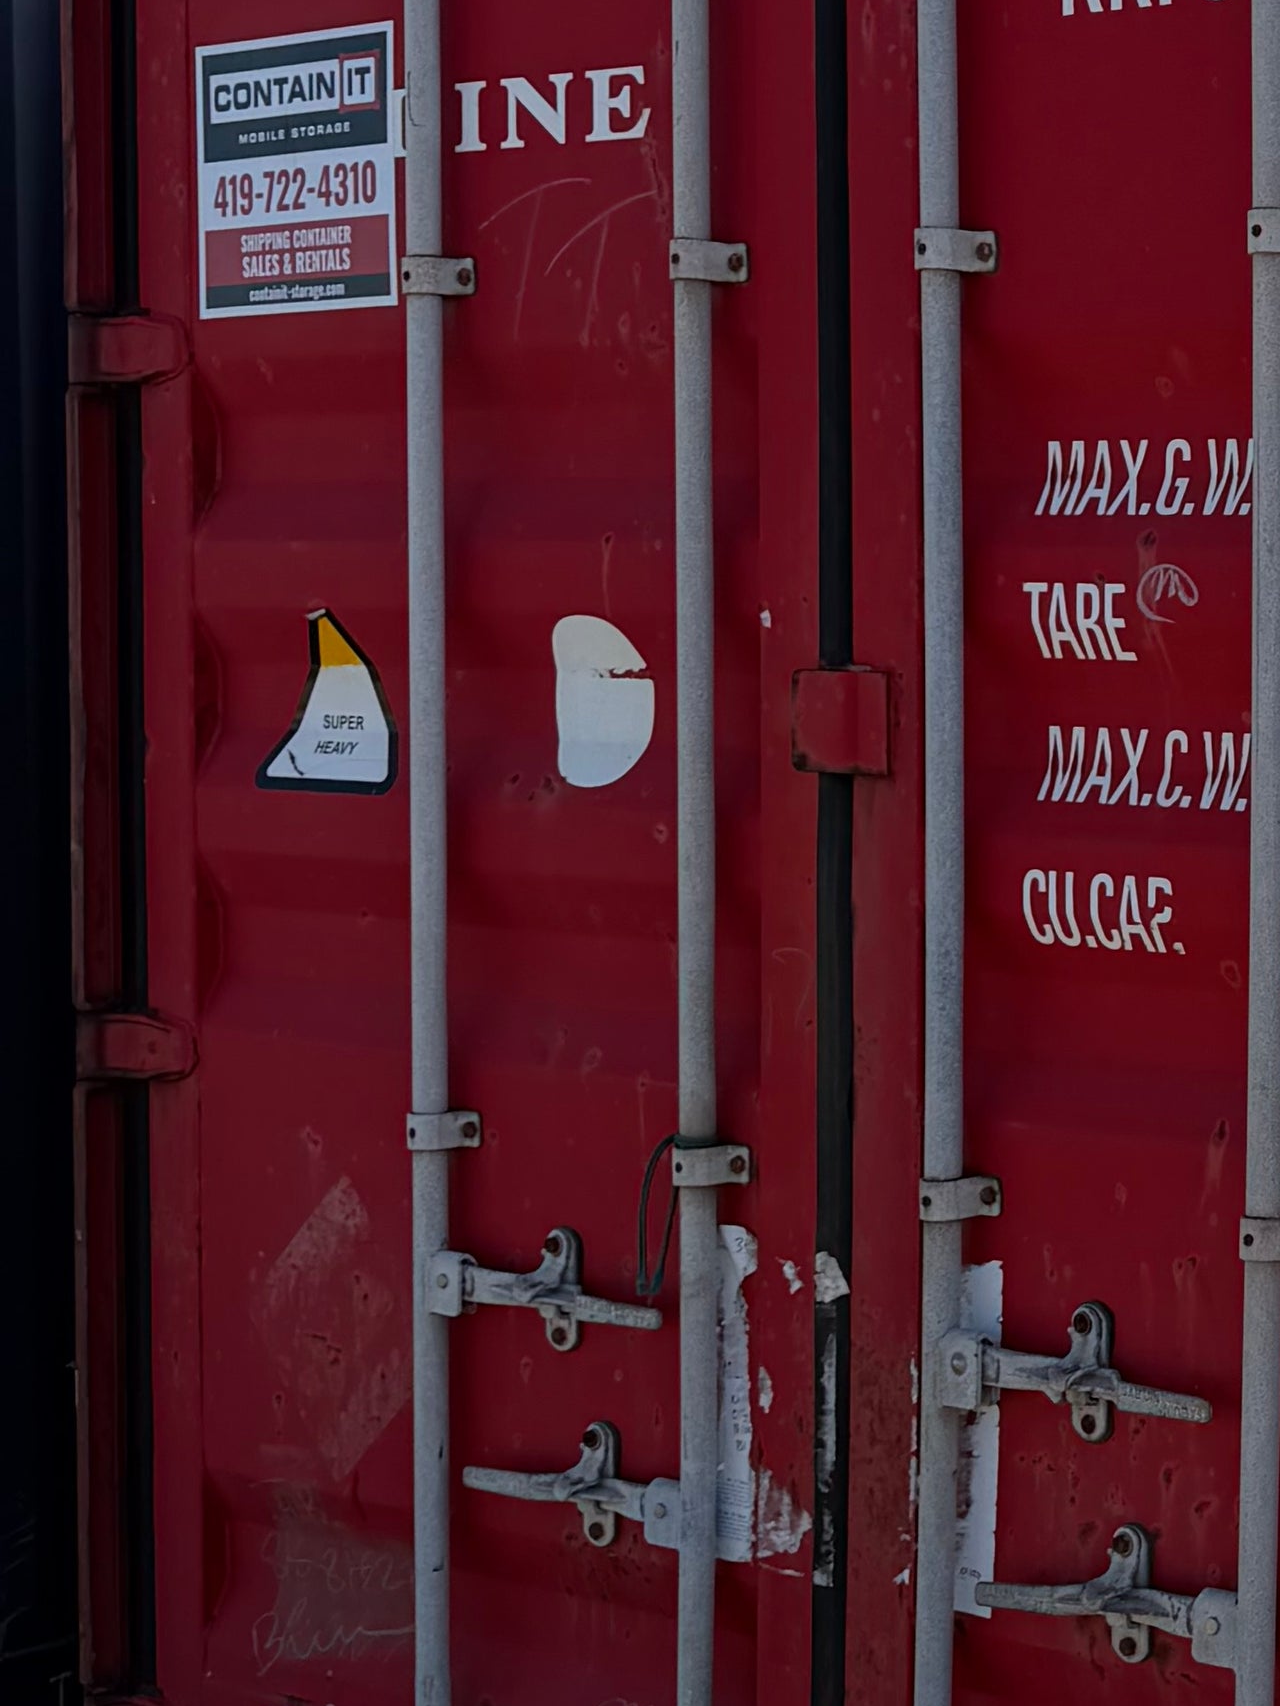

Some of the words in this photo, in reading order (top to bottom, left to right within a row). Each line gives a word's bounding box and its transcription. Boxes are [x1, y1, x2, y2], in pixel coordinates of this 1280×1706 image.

[238, 131, 286, 144] MOBILE
[290, 121, 352, 139] STORAGE
[393, 65, 651, 161] INE
[213, 159, 377, 218] 419-722-4310
[240, 231, 290, 253] SHIPPING
[293, 225, 353, 249] CONTAINER
[241, 254, 280, 278] SALES
[283, 255, 292, 272] &
[295, 248, 351, 273] RENTALS
[1035, 438, 1254, 516] MAX.G.W.
[1022, 581, 1139, 661] TARE
[323, 714, 364, 731] SUPER
[314, 740, 358, 756] HEAVY
[1037, 725, 1252, 812] MAX.C.W.
